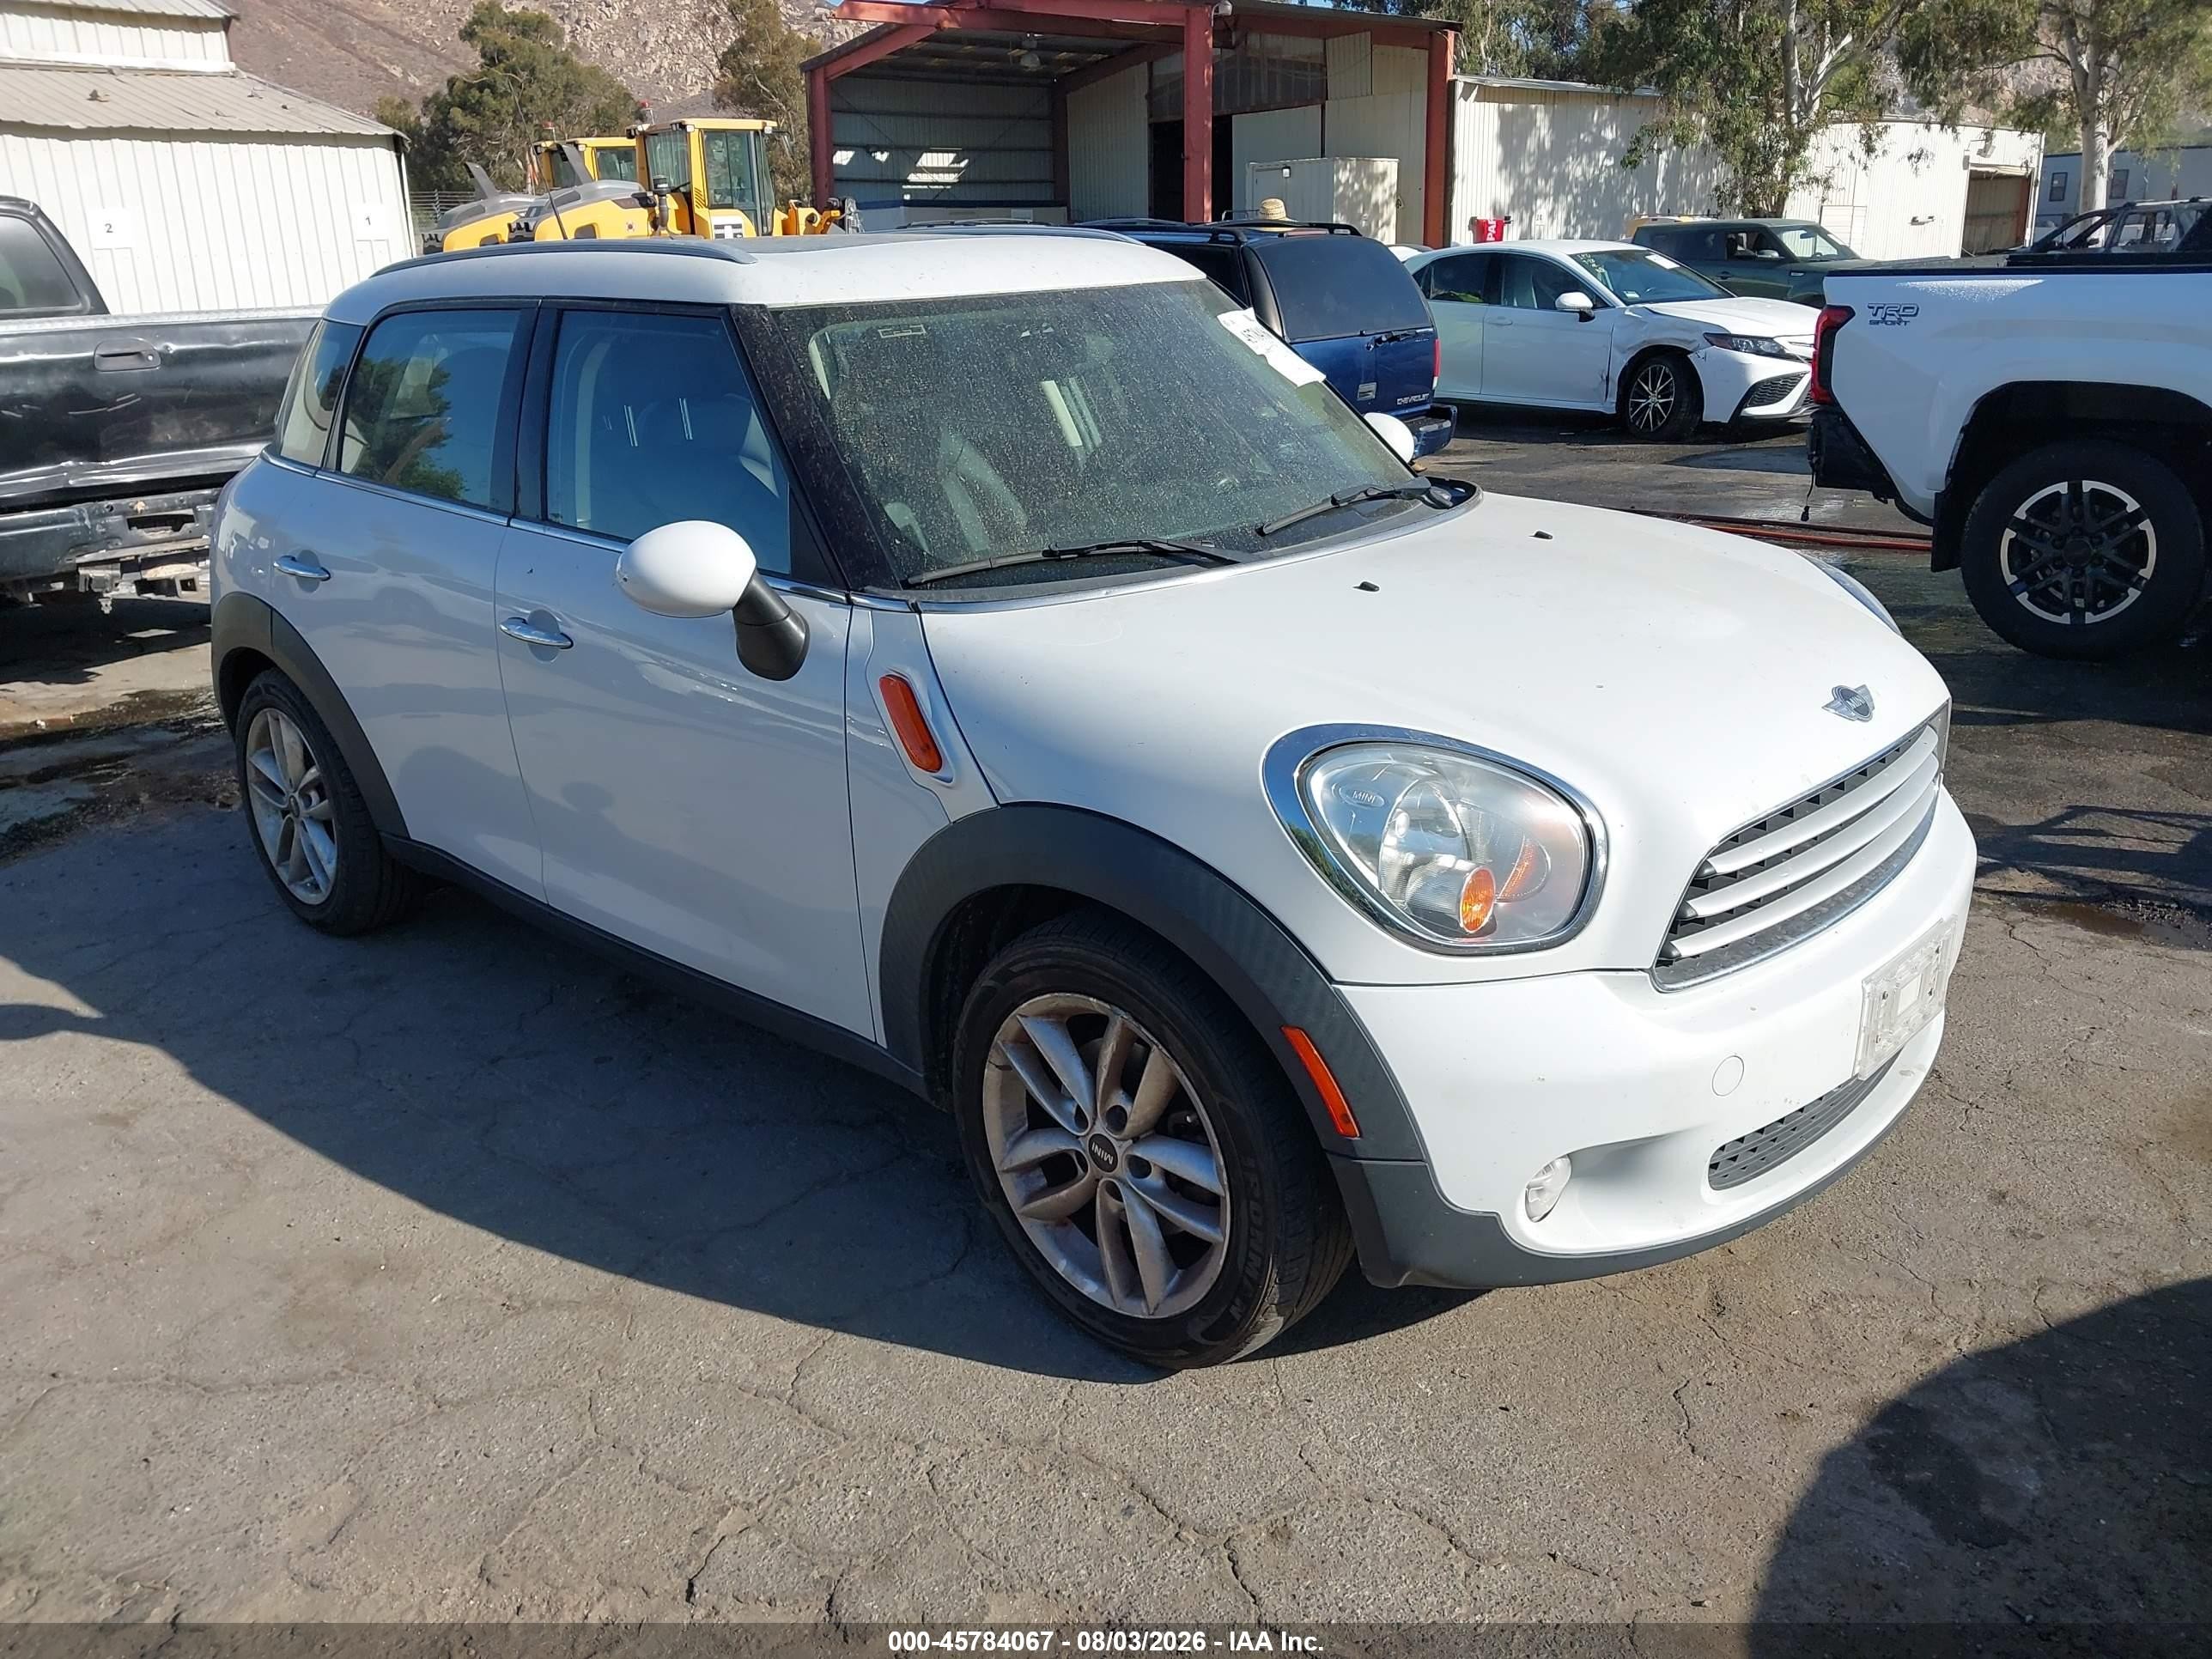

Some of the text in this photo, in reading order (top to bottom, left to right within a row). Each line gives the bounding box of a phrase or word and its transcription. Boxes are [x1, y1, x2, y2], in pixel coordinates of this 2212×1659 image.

[104, 222, 114, 234] 2
[1867, 302, 1920, 319] TRD
[1396, 393, 1430, 405] CHEVROLET
[1352, 790, 1376, 804] MINI
[1091, 1140, 1114, 1165] MINI
